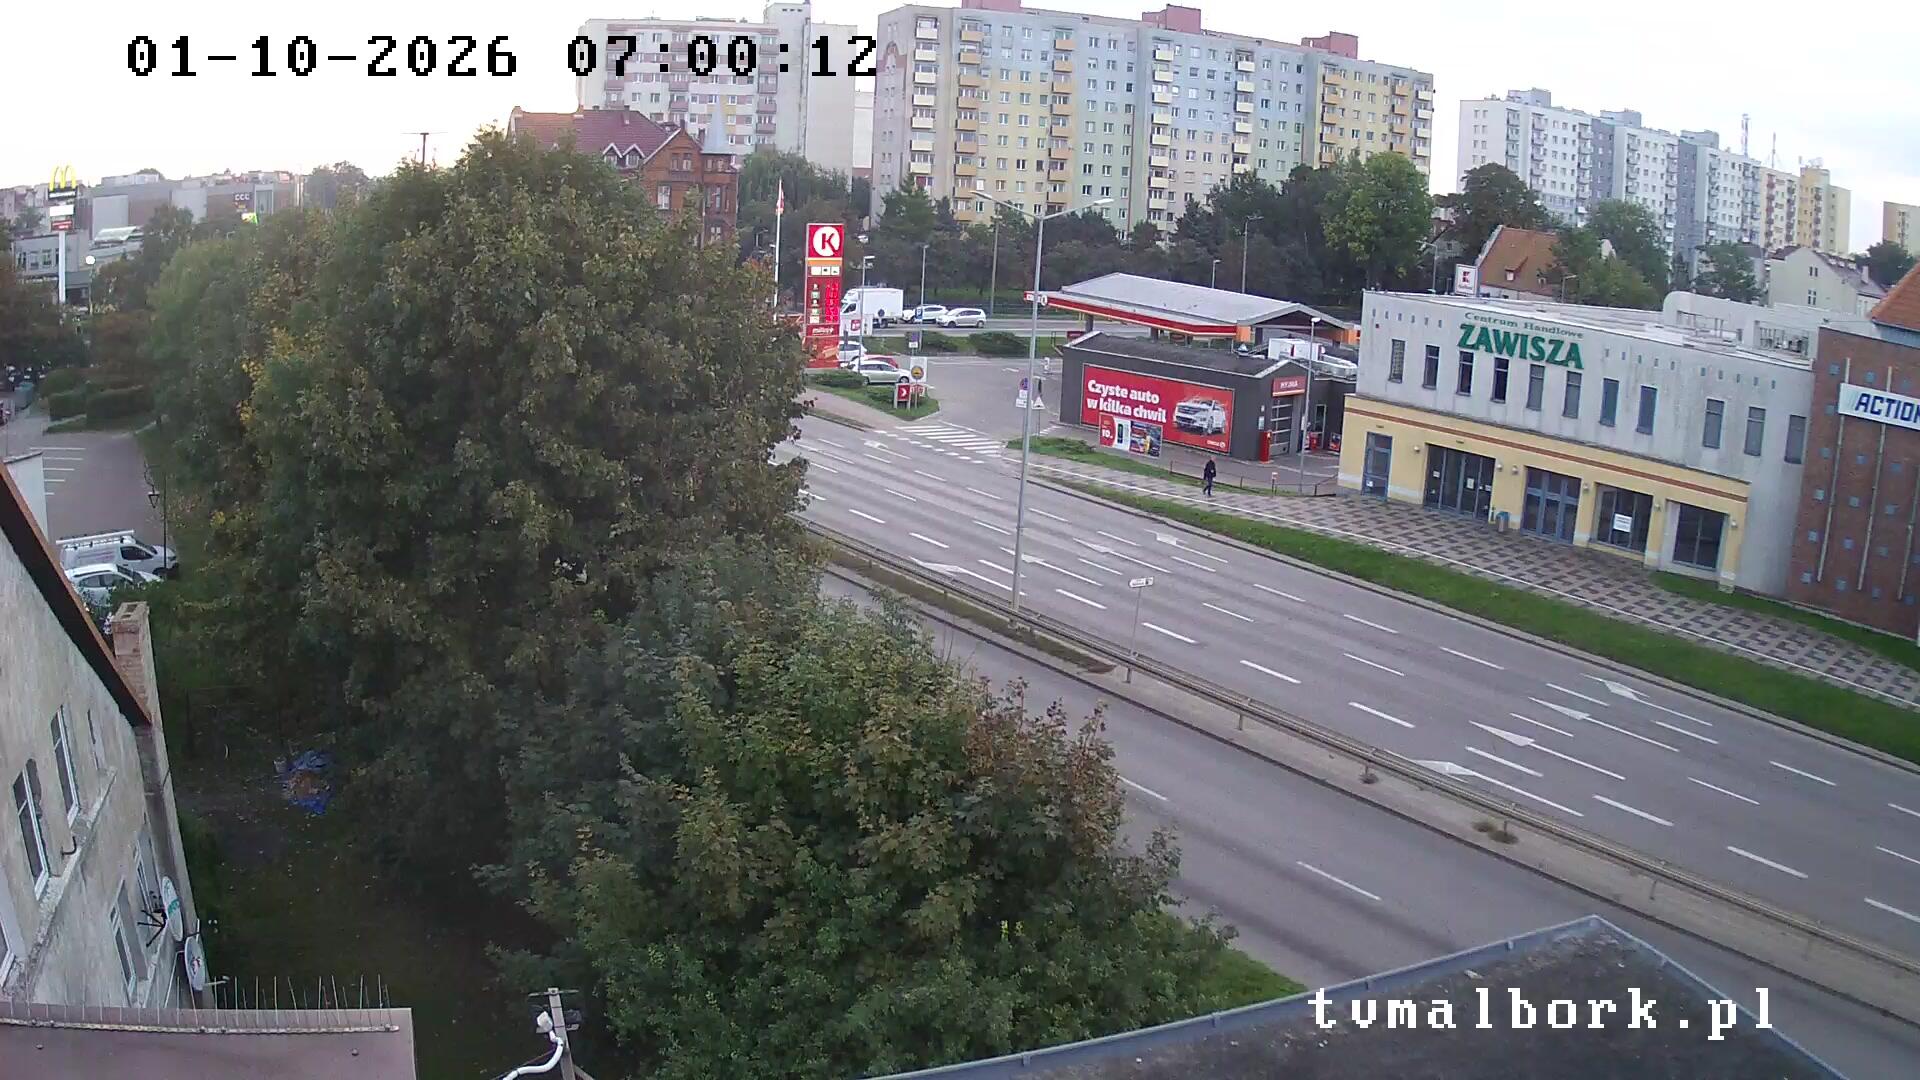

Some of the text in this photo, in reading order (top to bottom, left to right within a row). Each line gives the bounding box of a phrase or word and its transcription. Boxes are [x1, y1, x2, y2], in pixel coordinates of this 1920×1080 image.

[235, 193, 250, 201] CCC
[1465, 312, 1584, 339] Centrum Handlowe
[1457, 323, 1584, 370] ZAWISZA
[1088, 379, 1160, 404] Czyste auto
[1087, 398, 1099, 410] w
[1099, 397, 1132, 416] kilka
[1133, 405, 1167, 423] chwil
